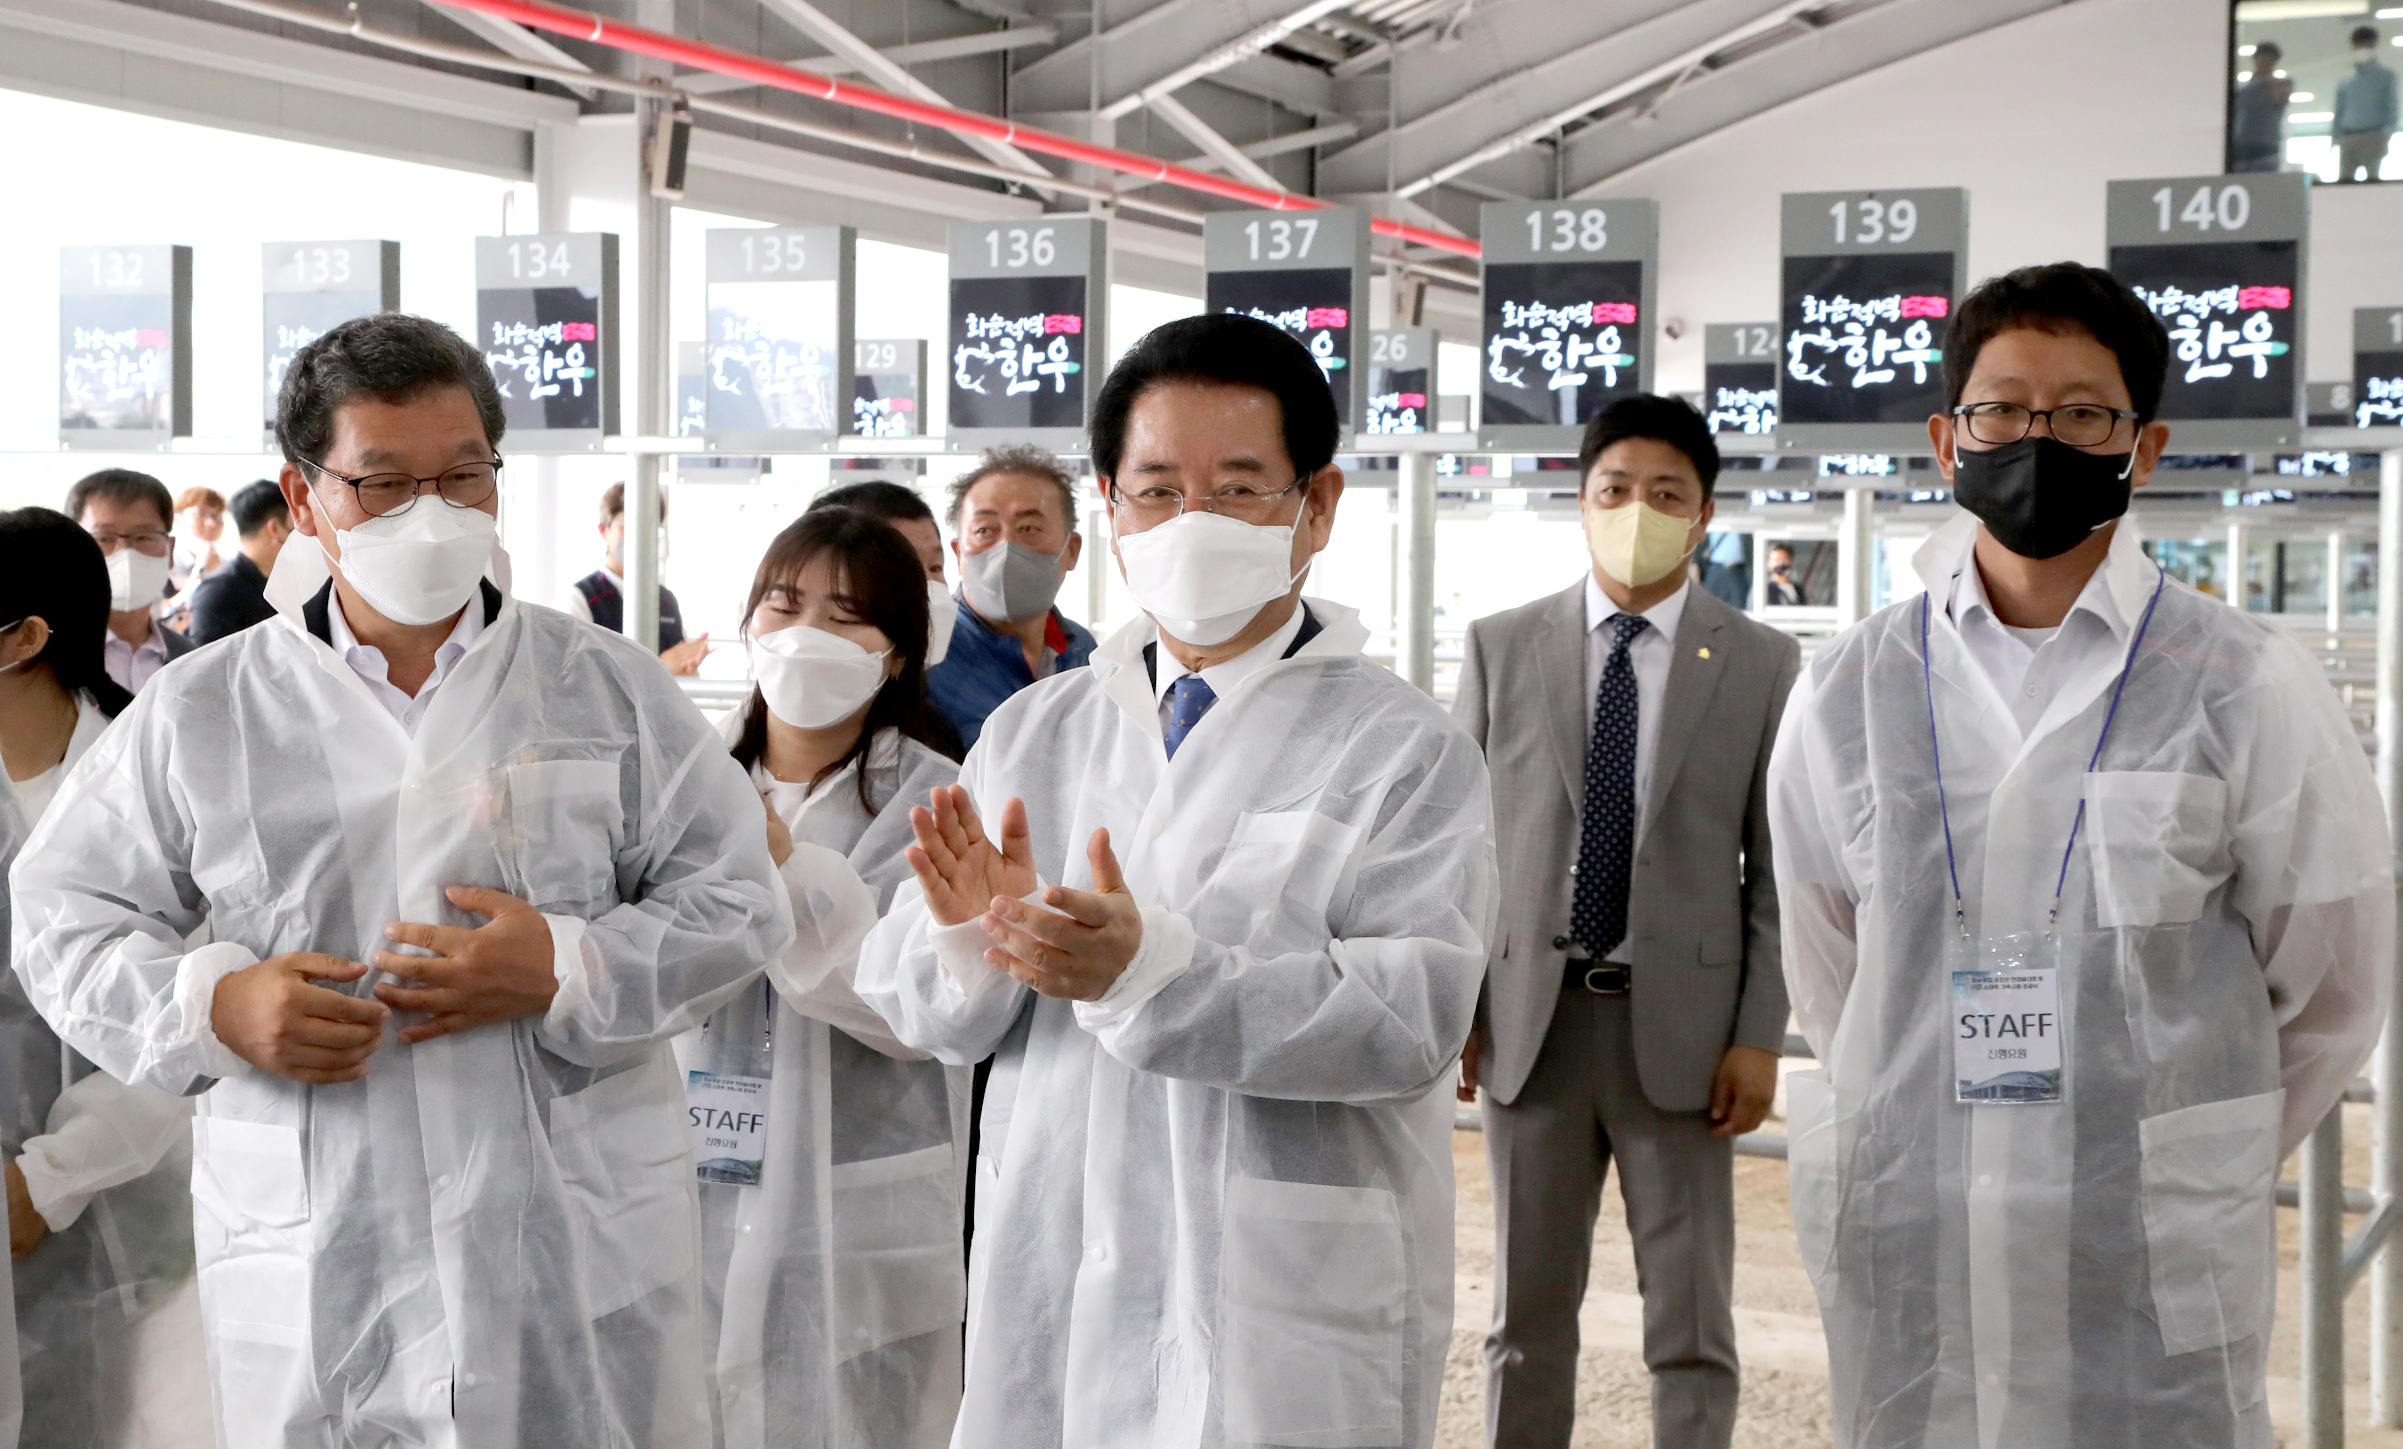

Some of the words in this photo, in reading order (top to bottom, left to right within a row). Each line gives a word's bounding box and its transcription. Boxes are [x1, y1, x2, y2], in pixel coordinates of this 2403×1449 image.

[1829, 199, 1918, 244] 139
[2152, 184, 2250, 232] 140
[985, 227, 1055, 268] 136
[1245, 218, 1319, 261] 137
[1525, 209, 1607, 252] 138
[90, 252, 144, 287] 132
[293, 248, 351, 284] 133
[508, 241, 571, 279] 134
[741, 234, 806, 273] 135
[966, 312, 1045, 341] 화순적벽
[1502, 300, 1594, 332] 화순적벽
[1801, 294, 1902, 326] 화순적벽
[995, 336, 1081, 397] 한우
[1372, 333, 1408, 362] 26
[1535, 325, 1635, 391] 한우
[1838, 320, 1942, 388] 한우
[2168, 311, 2290, 383] 한우
[97, 348, 165, 402] 한우
[519, 342, 596, 400] 한우
[750, 340, 831, 398] 한우
[1960, 1012, 2053, 1039] STAFF
[1988, 1048, 2028, 1060] 진행요원
[688, 1106, 764, 1134] STAFF
[705, 1136, 738, 1149] 진행요원
